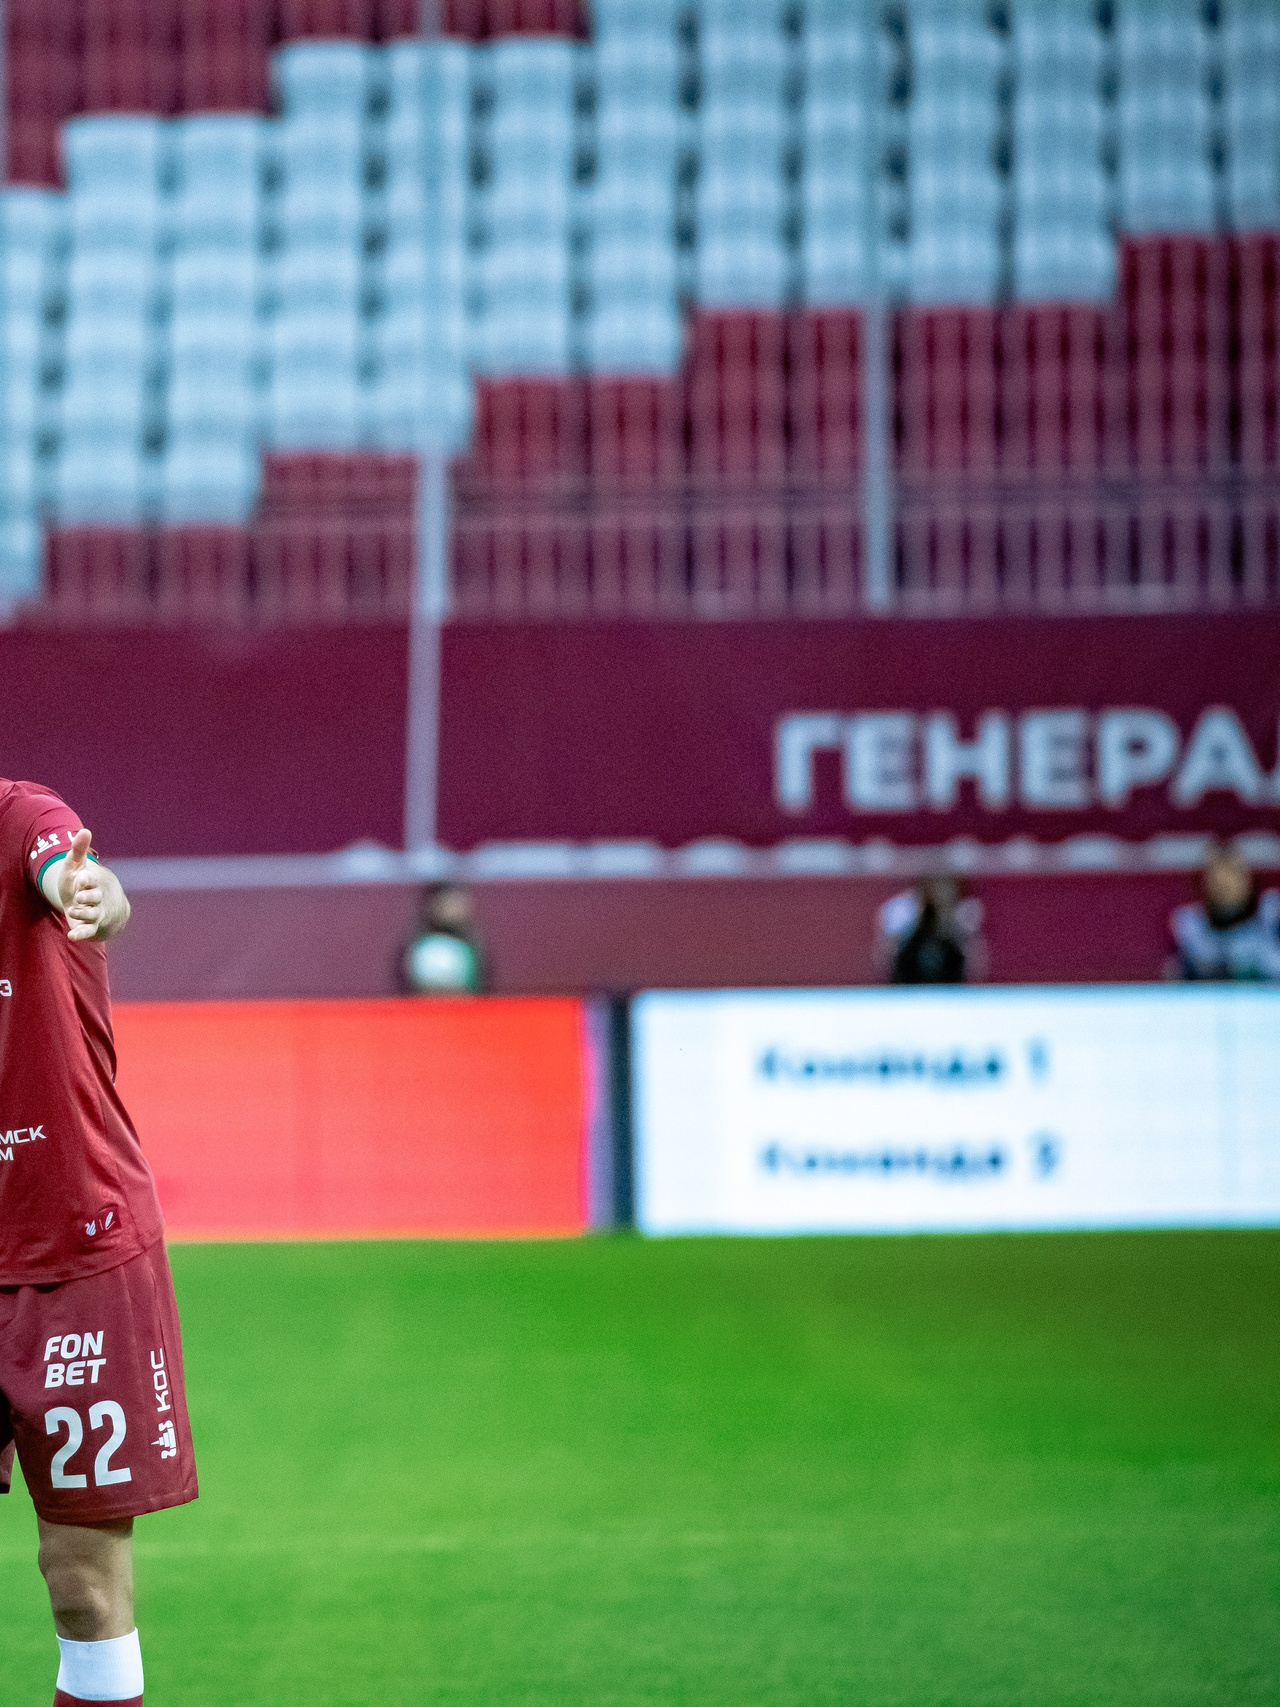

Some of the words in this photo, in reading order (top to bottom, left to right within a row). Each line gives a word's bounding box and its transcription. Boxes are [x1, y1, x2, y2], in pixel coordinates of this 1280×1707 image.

[775, 706, 1280, 811] ГЕНЕРА
[43, 1330, 104, 1361] FON
[44, 1358, 107, 1389] BET
[150, 1347, 171, 1412] КОС
[44, 1399, 132, 1489] 22
